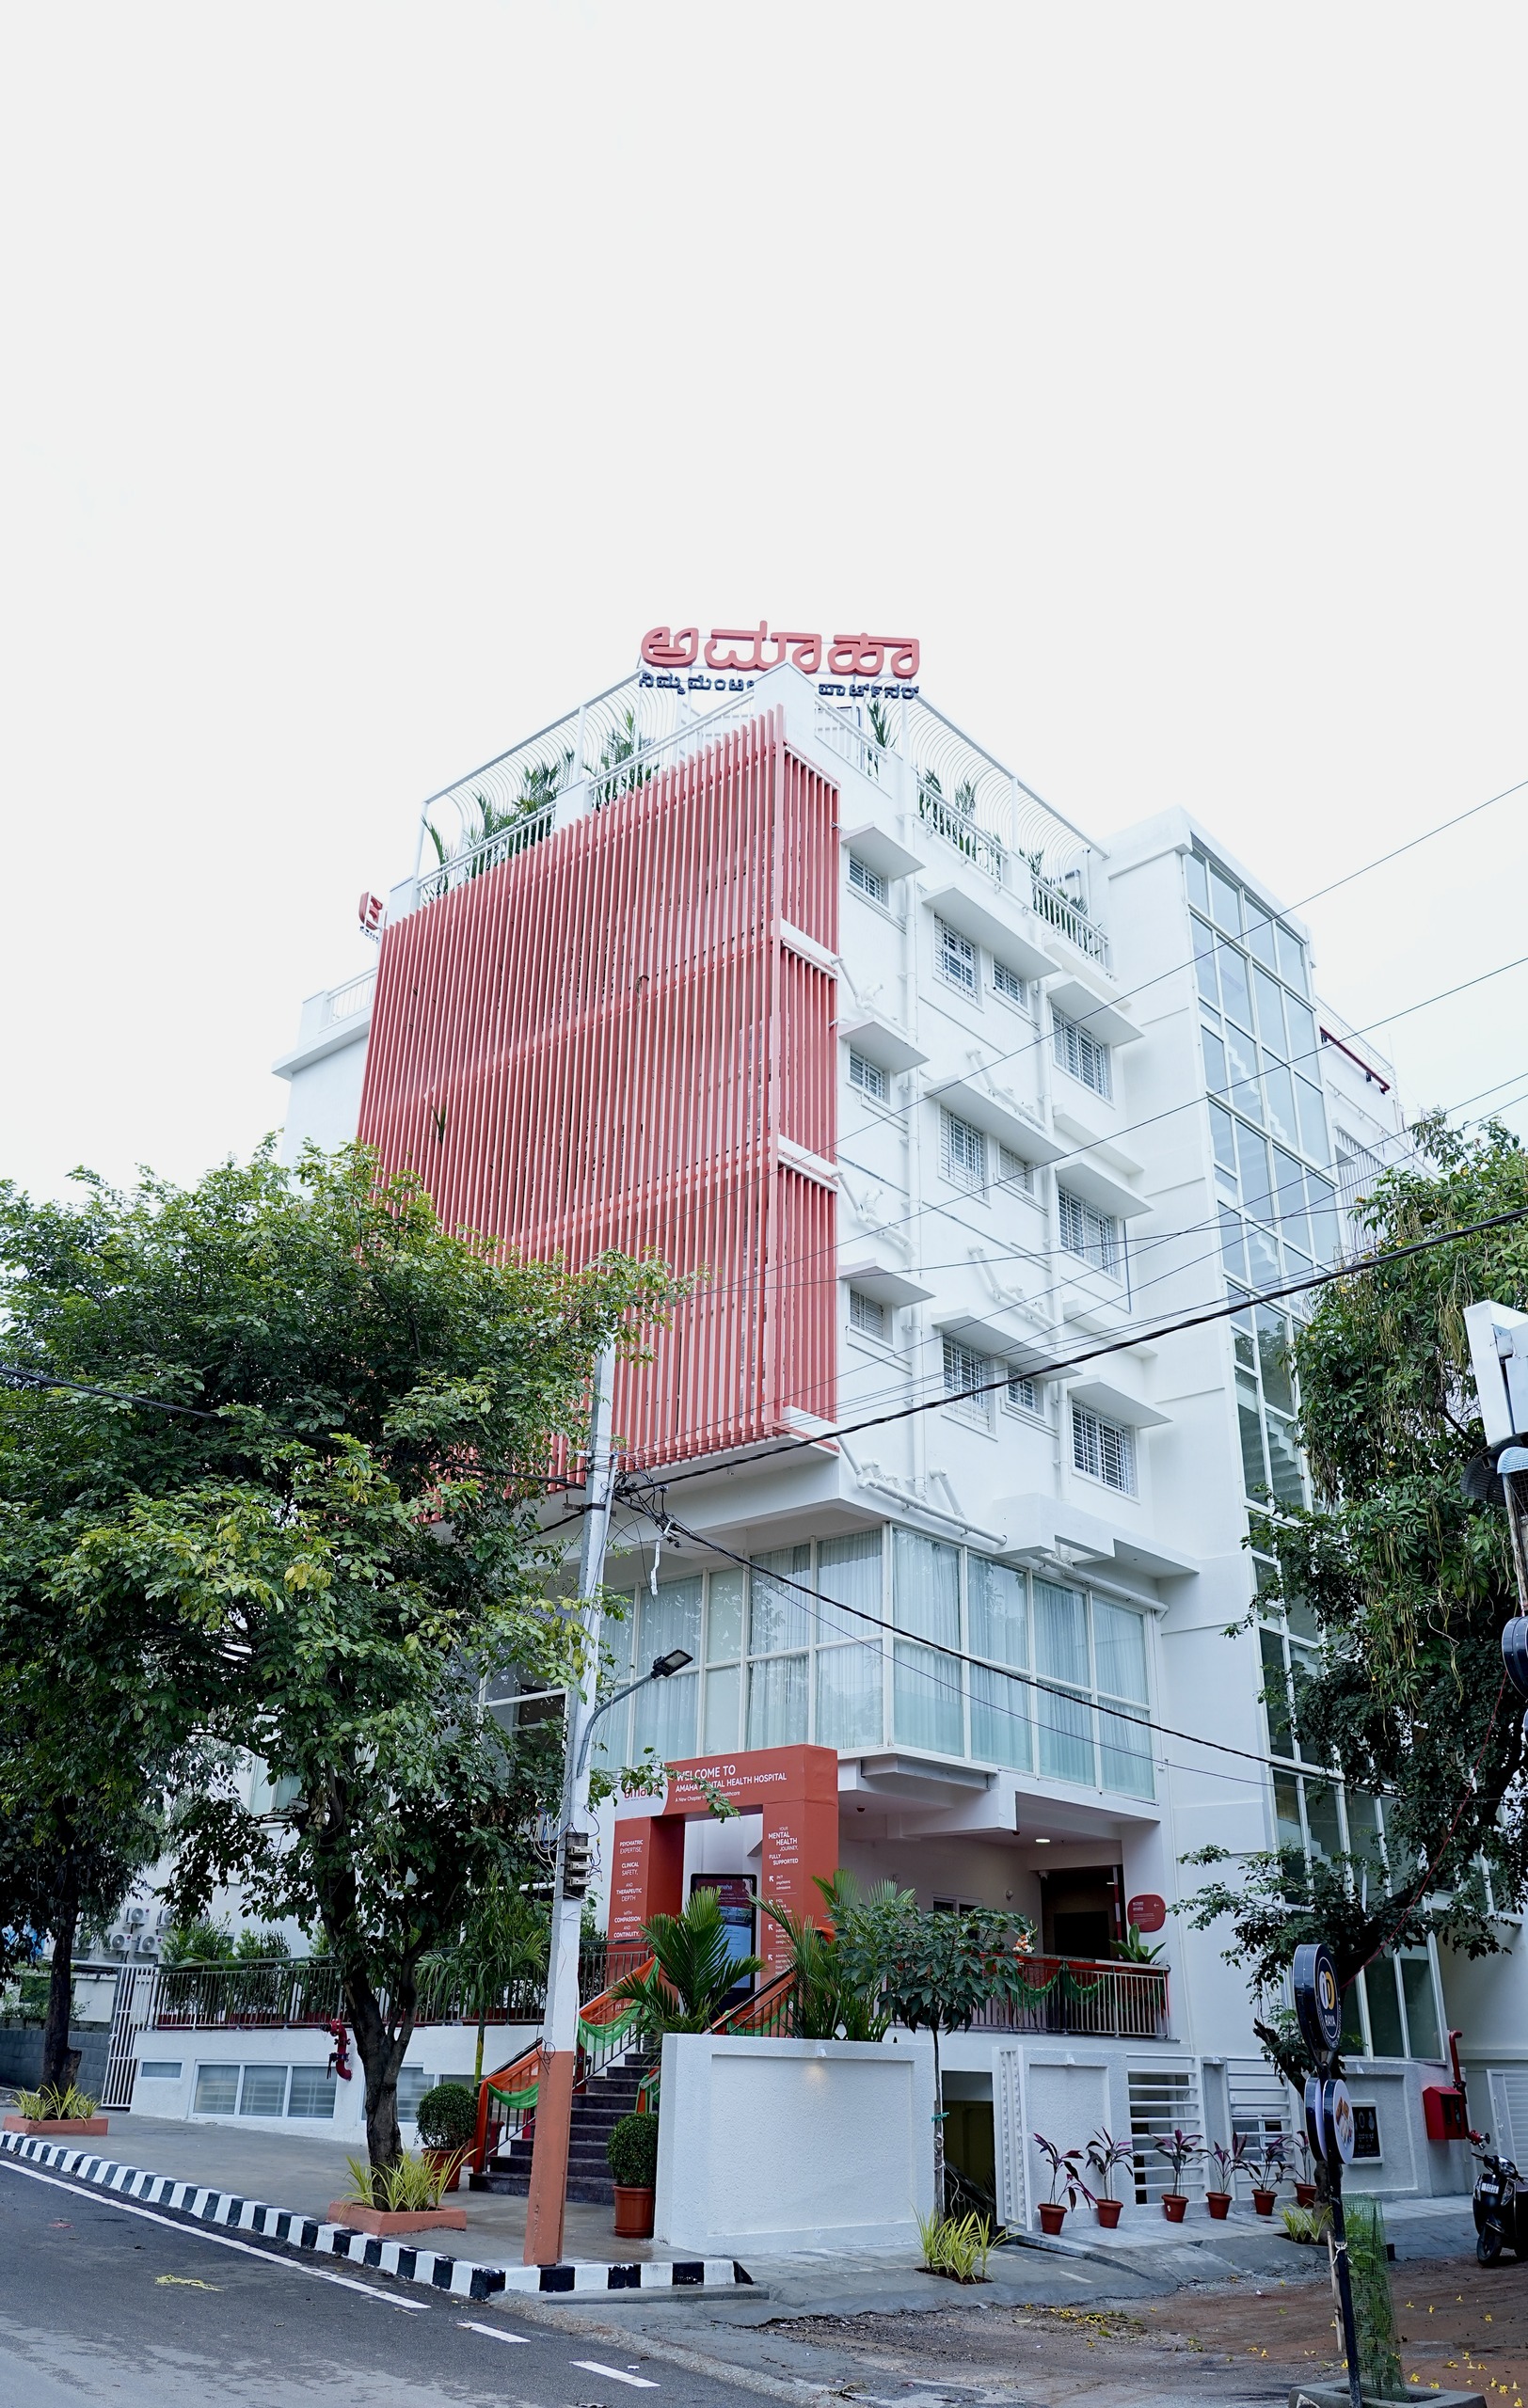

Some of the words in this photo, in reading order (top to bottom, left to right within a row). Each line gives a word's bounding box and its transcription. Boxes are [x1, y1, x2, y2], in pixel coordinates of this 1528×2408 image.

[641, 620, 920, 679] ಅಮಾಹಾ
[639, 672, 686, 695] ನಿಮ್ಮ
[688, 674, 755, 691] ಮೆಂಟ
[676, 1766, 721, 1782] WELCOME
[723, 1765, 736, 1776] TO
[675, 1784, 698, 1793] AMAHA
[699, 1780, 725, 1790] MNTAL
[726, 1776, 753, 1786] HEALTH
[754, 1772, 788, 1783] HOSPITAL
[768, 1831, 790, 1840] MENTAL
[775, 1837, 798, 1846] HEALTH
[772, 1858, 799, 1866] SUPPORTED
